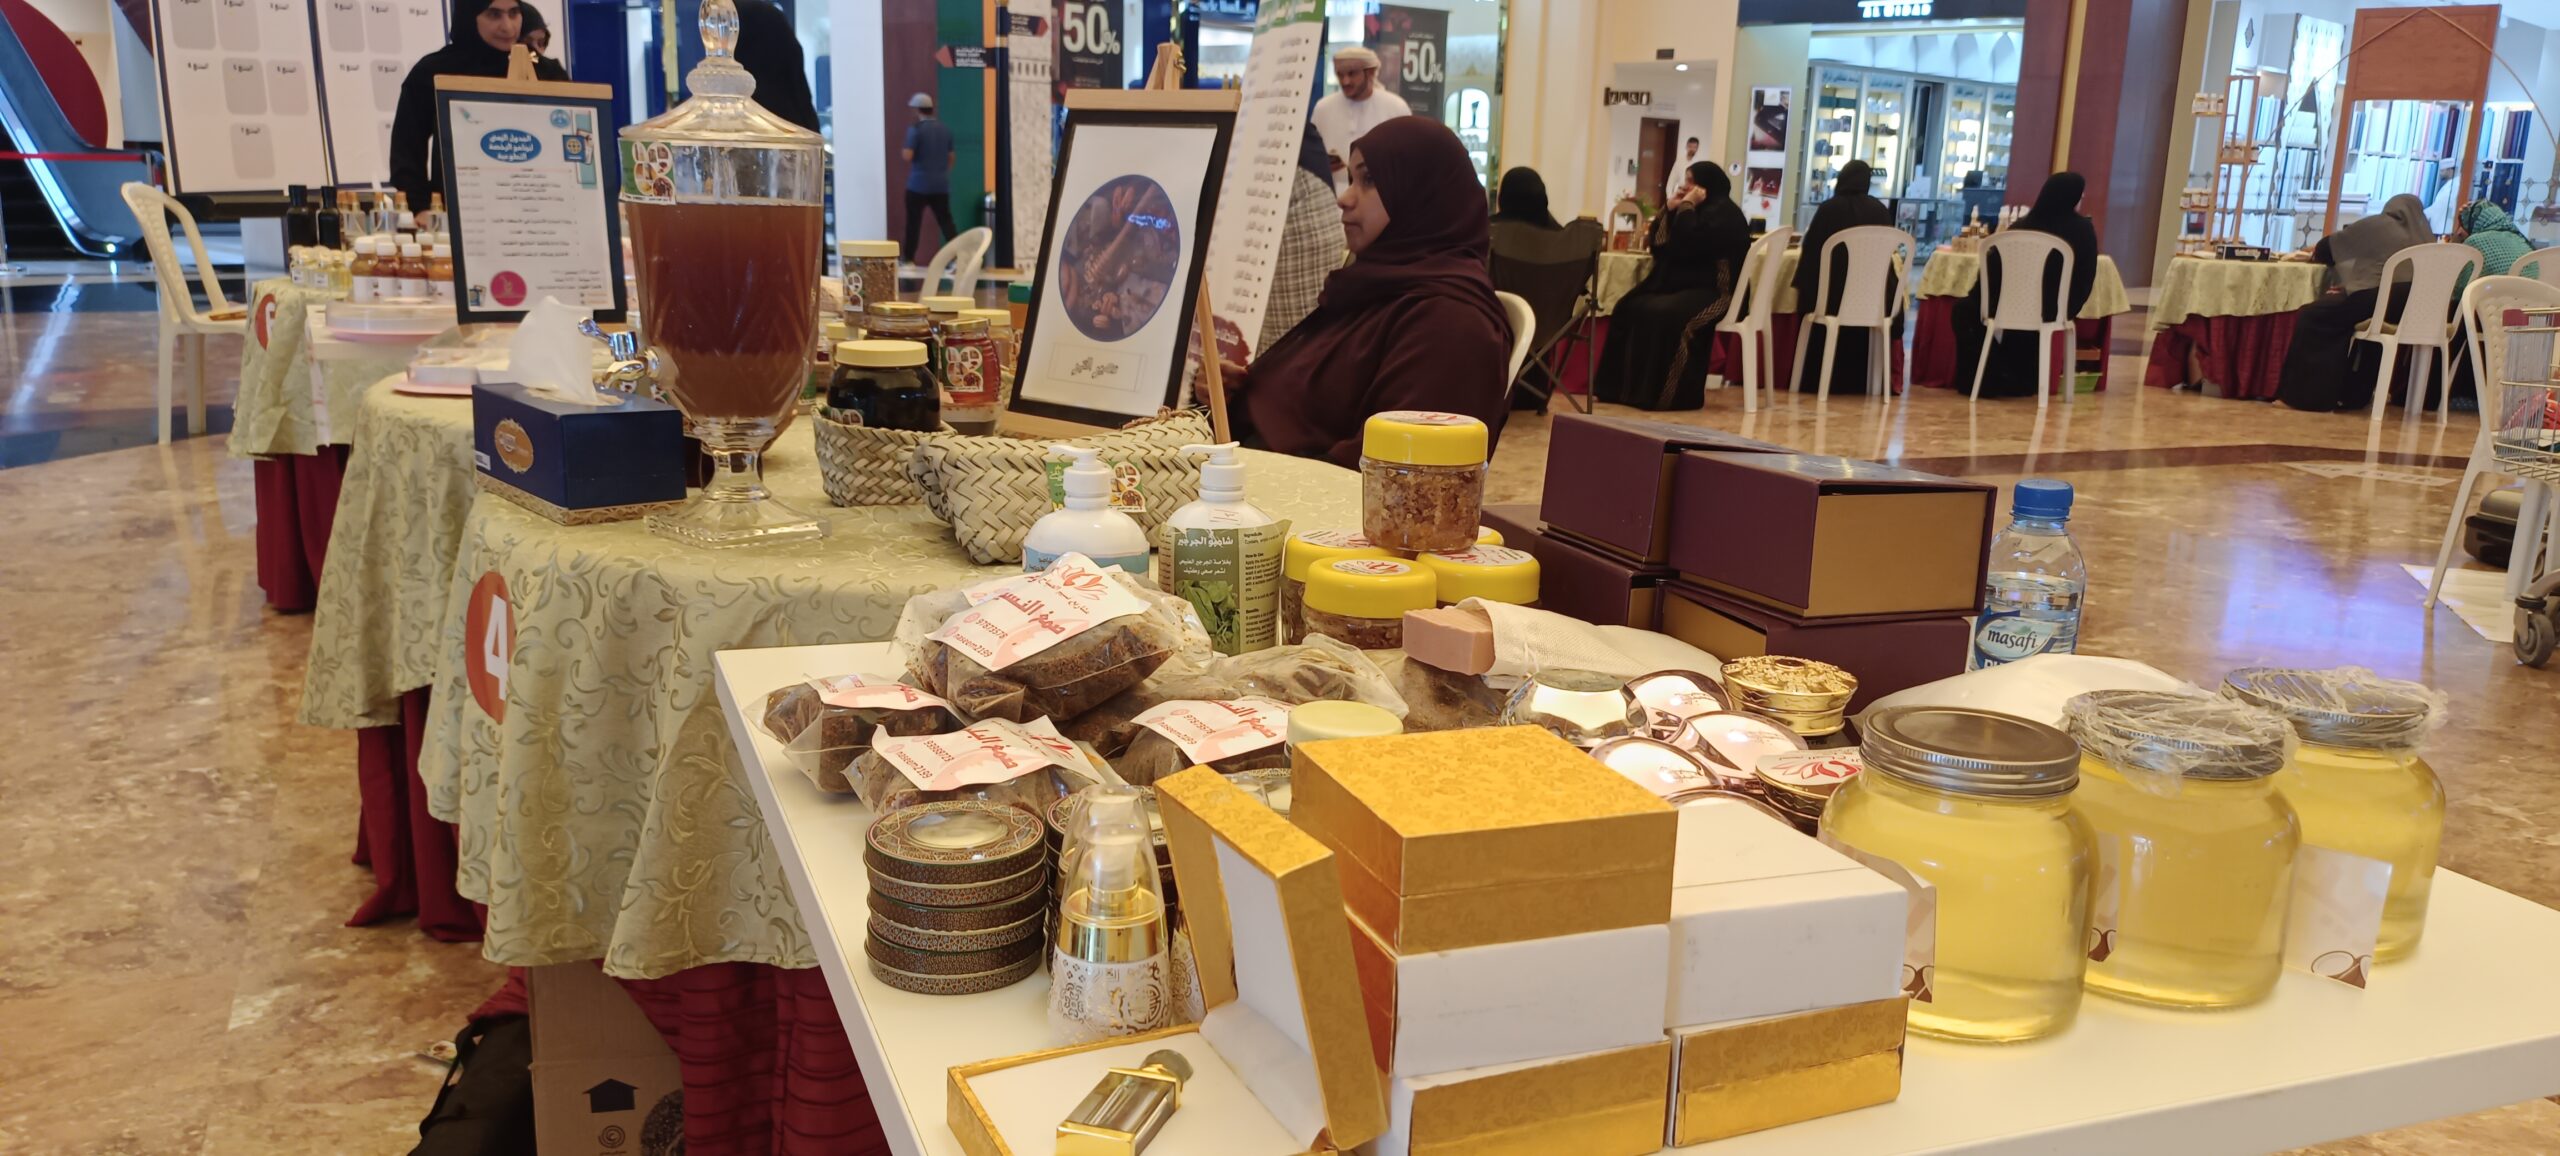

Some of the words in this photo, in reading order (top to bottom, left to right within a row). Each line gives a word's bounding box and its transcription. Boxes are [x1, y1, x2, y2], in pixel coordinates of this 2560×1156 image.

[1063, 2, 1120, 54] 50%
[1403, 40, 1443, 83] 50%
[1177, 535, 1207, 547] الجرجير
[1208, 535, 1233, 548] شامبو
[484, 594, 509, 701] 4
[1988, 630, 2038, 653] masafi
